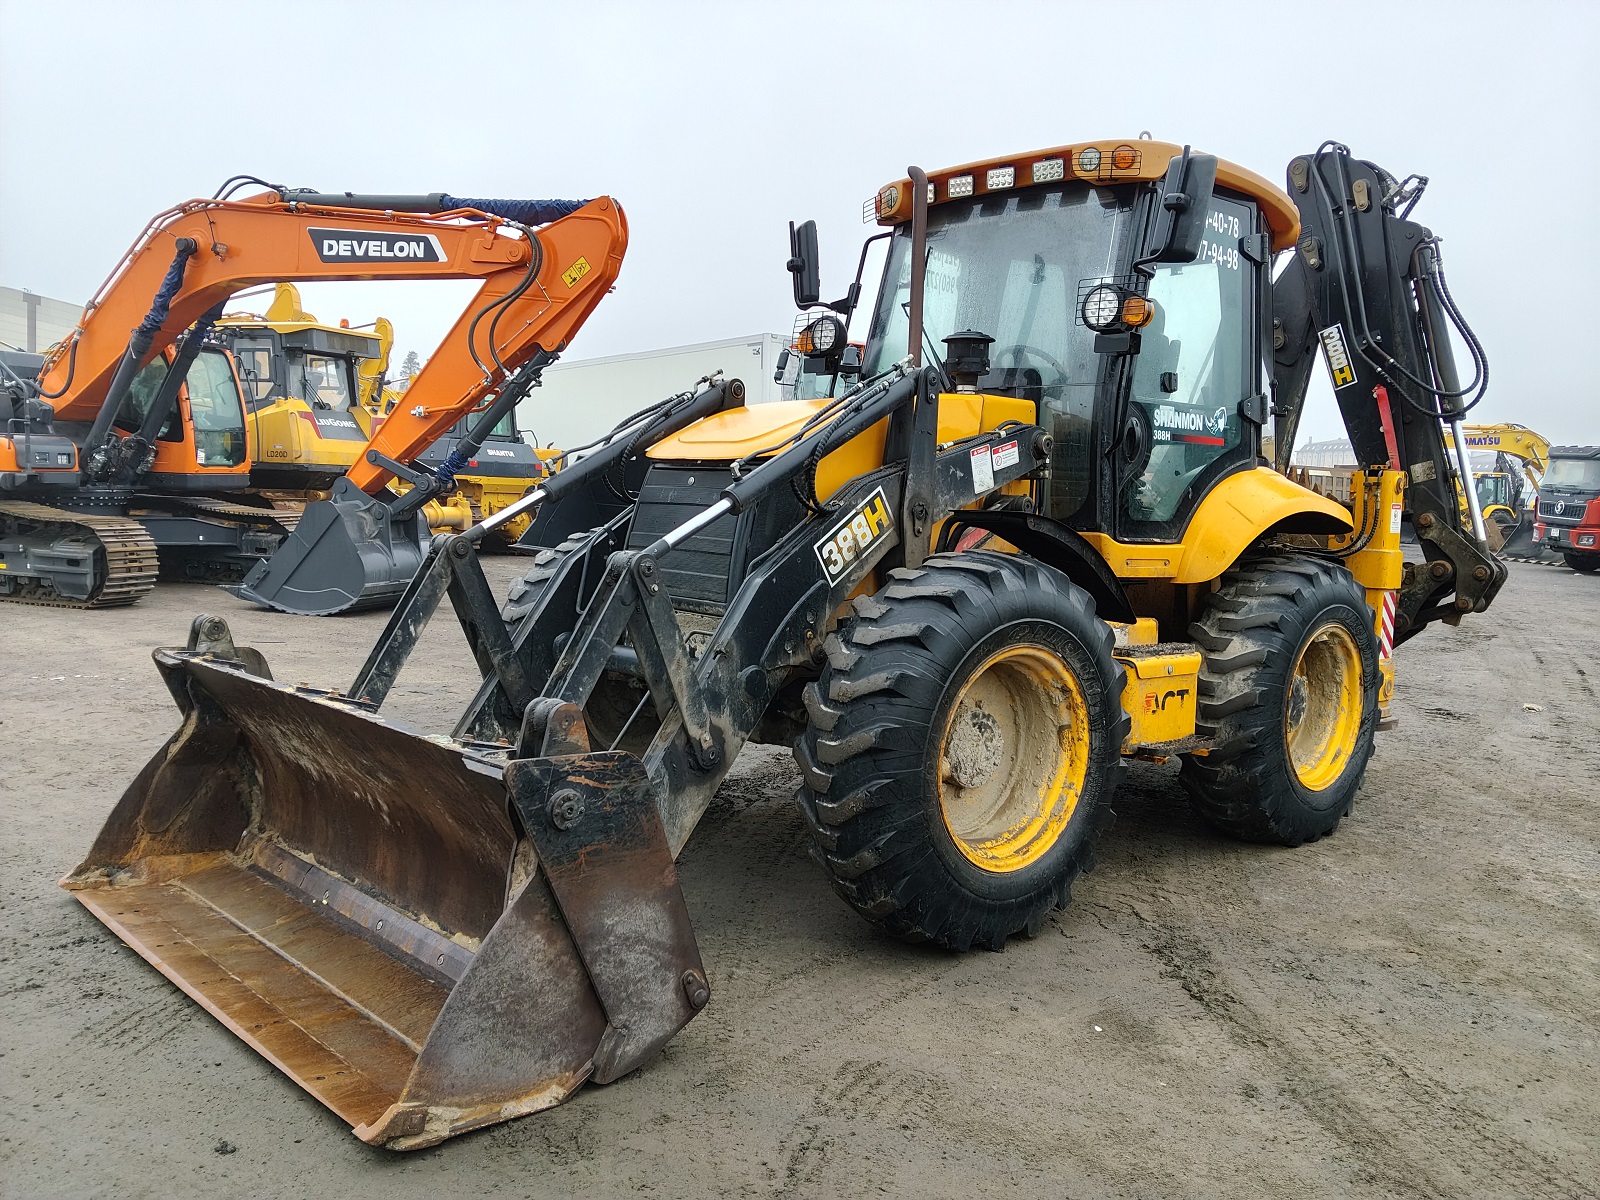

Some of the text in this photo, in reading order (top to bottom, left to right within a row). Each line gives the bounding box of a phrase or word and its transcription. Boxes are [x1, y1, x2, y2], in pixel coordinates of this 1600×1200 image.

[322, 239, 425, 258] DEVELON
[1322, 327, 1353, 386] 388H
[316, 418, 357, 429] LIUGONG
[1153, 408, 1204, 432] SHANMON
[1153, 429, 1171, 441] 388H
[1464, 435, 1501, 446] MATSU
[266, 450, 288, 458] LD20D
[486, 449, 515, 458] SHANTUI
[821, 496, 890, 575] 388H
